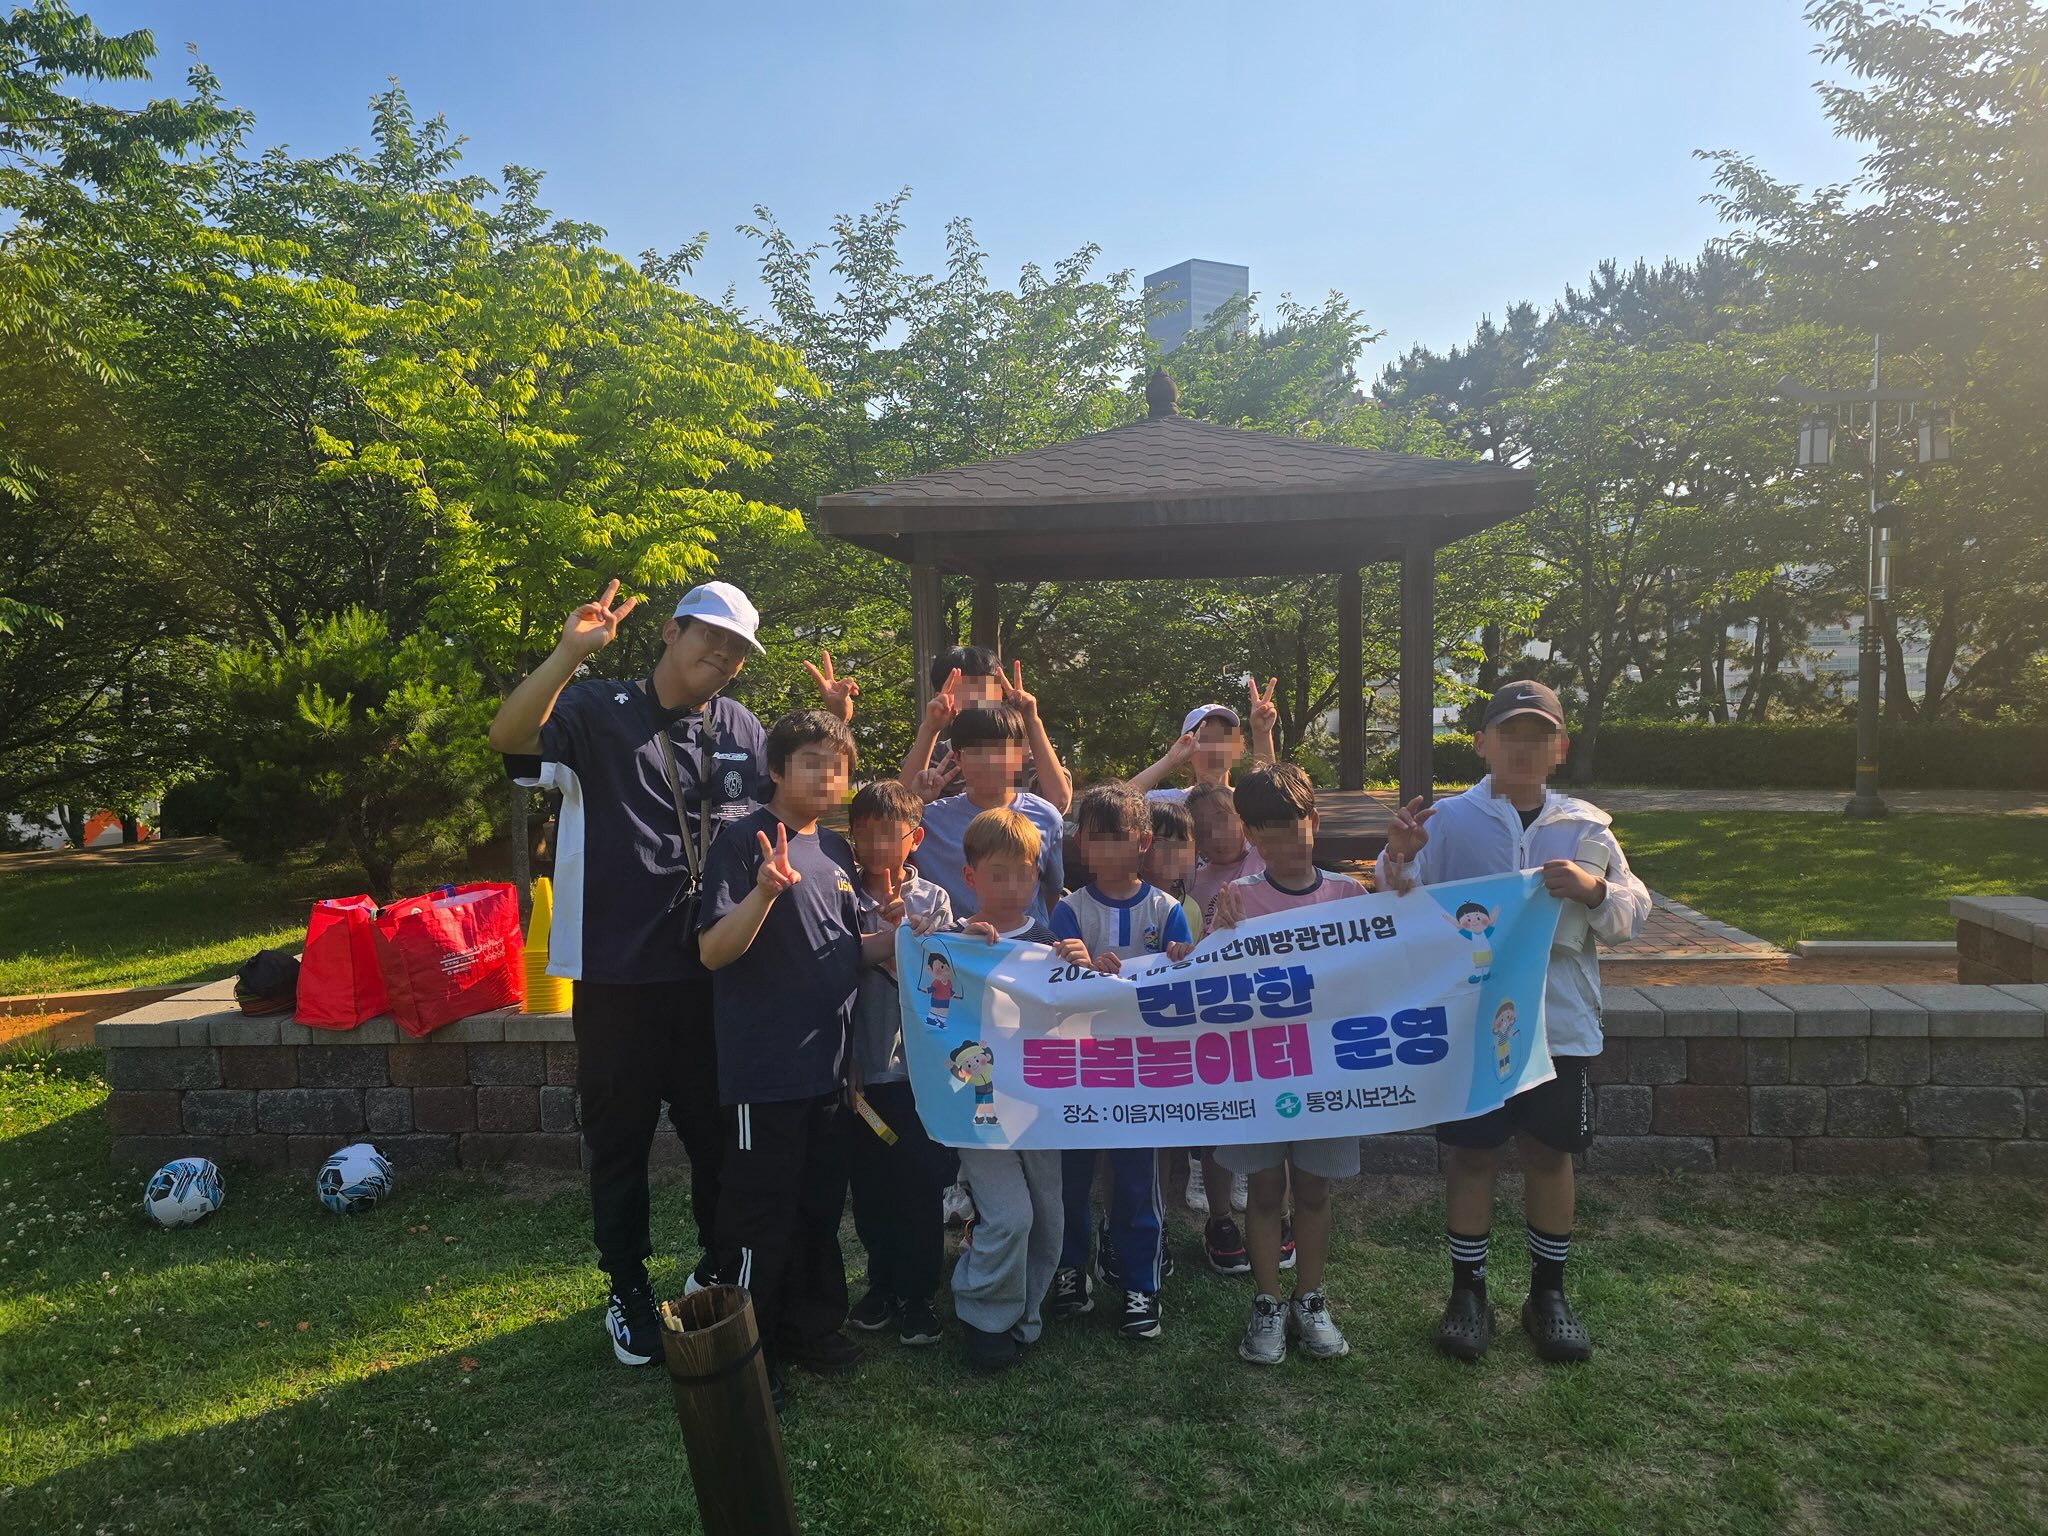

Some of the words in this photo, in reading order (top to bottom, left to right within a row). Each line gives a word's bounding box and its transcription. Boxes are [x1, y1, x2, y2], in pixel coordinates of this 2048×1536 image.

[1136, 964, 1315, 1028] 건강한
[1023, 1023, 1313, 1089] 돌봄놀이터
[1331, 1005, 1449, 1071] 운영
[1063, 1104, 1099, 1124] 장소
[1112, 1098, 1257, 1124] 이음지역아동센터
[1306, 1084, 1417, 1113] 통영시보건소
